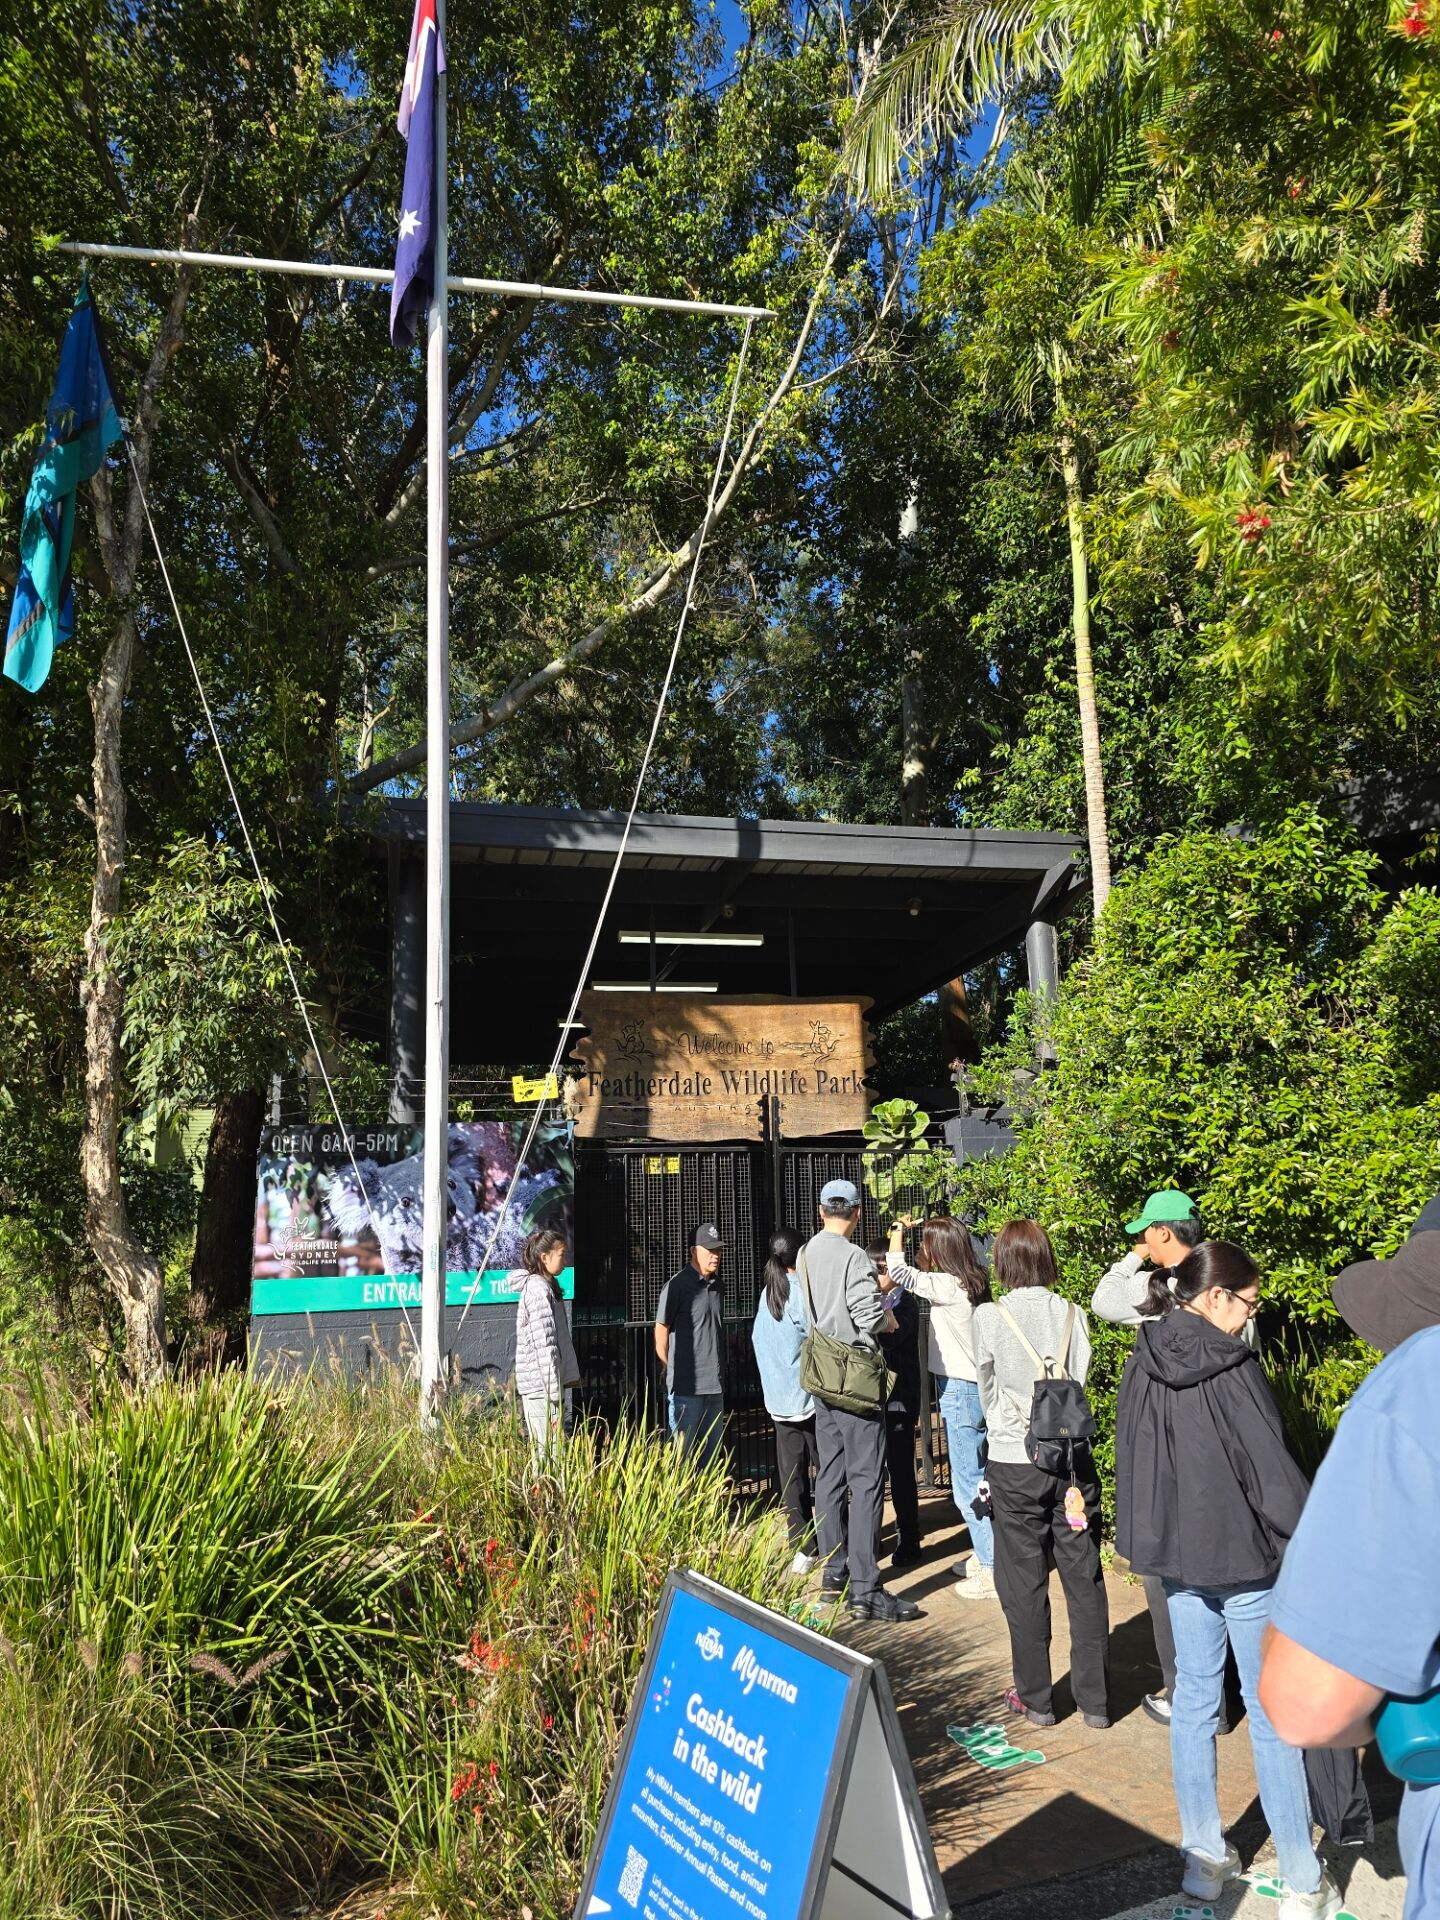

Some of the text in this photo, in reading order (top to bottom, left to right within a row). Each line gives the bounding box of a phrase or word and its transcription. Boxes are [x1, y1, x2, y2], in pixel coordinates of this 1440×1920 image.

[677, 1033, 774, 1055] Welcome to
[587, 1070, 863, 1097] Featherdale Wildlife Park
[271, 1134, 313, 1153] OPEN
[290, 1250, 338, 1259] SYDNEY
[291, 1241, 338, 1250] FEATHERDALE
[695, 1631, 724, 1660] NRMA
[686, 1693, 768, 1771] Cashback
[673, 1727, 762, 1814] in the wild
[646, 1766, 772, 1873] My NRMA members get 10% cashback on
[641, 1786, 767, 1895] all purchases including entry, food, animal
[660, 1825, 684, 1855] Explorer
[683, 1847, 707, 1875] Annual
[706, 1865, 729, 1893] Passes
[729, 1887, 746, 1906] and
[745, 1900, 767, 1920] more
